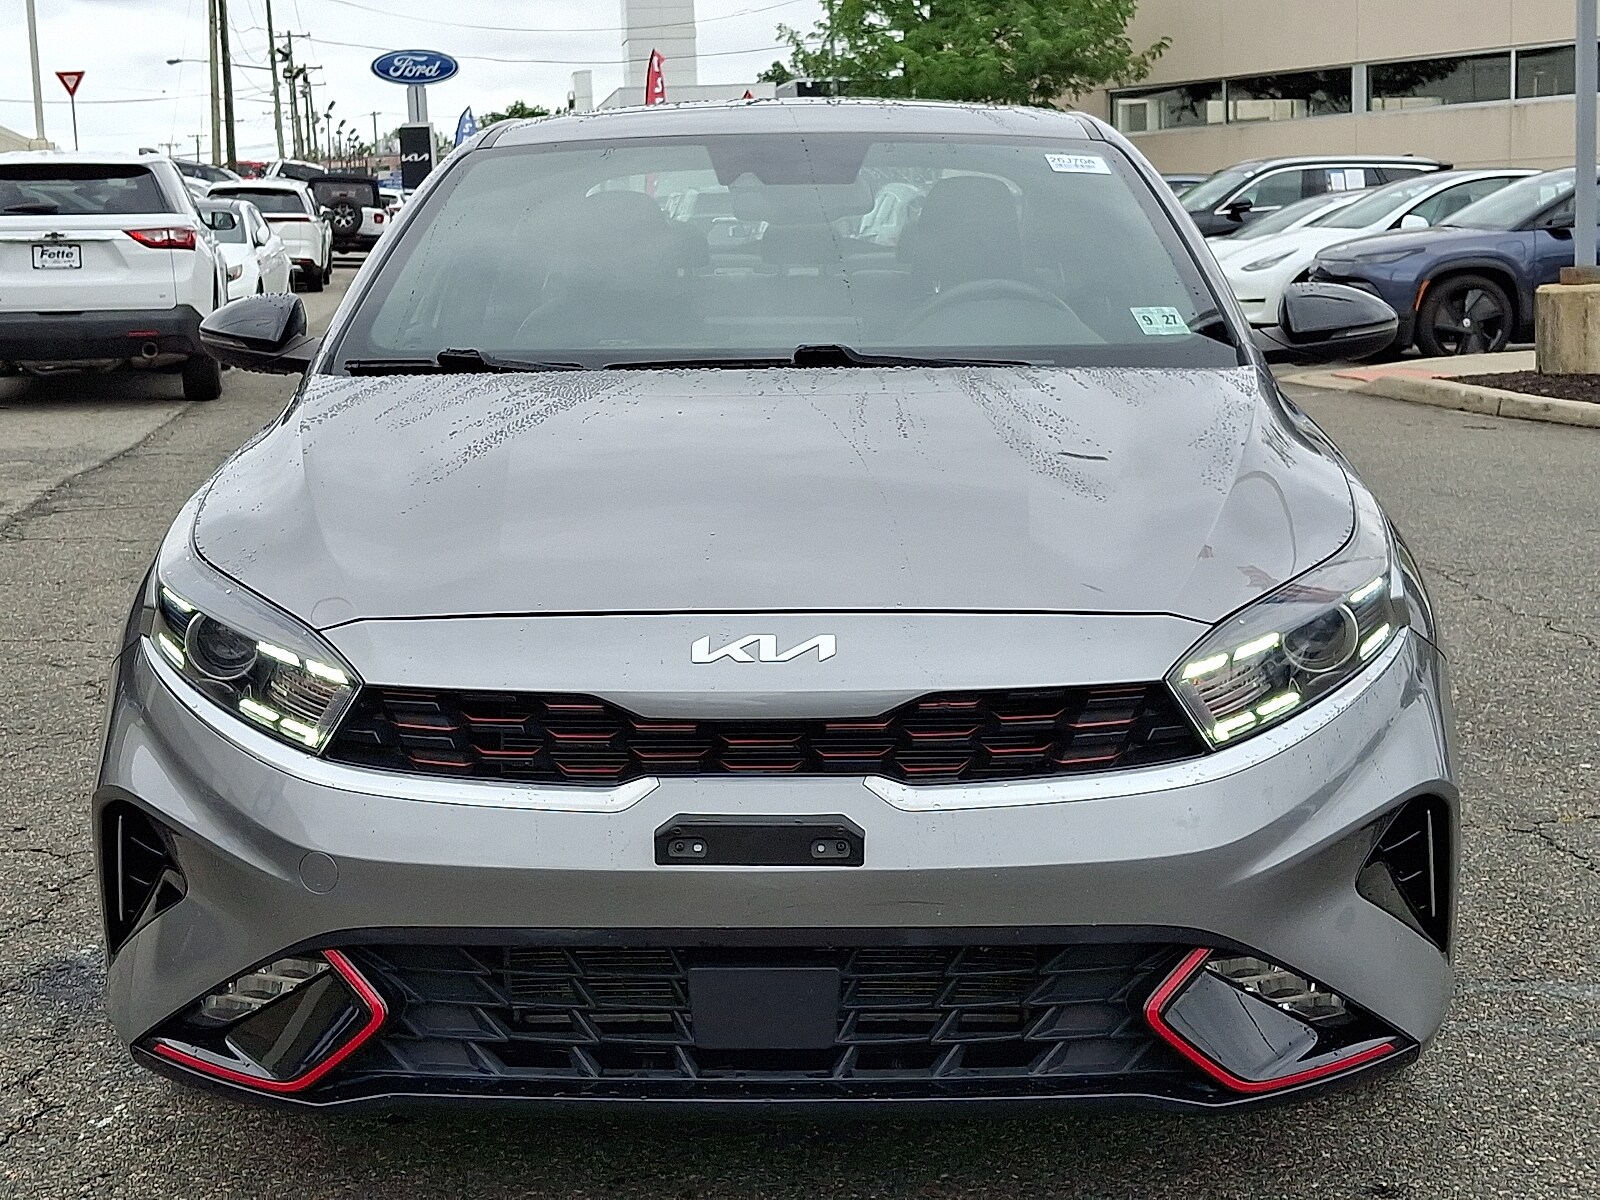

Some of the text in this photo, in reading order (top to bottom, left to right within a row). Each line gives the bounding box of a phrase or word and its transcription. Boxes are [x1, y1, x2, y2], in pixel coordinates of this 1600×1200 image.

[389, 55, 441, 78] Ford
[401, 152, 430, 162] KIA
[1142, 314, 1177, 325] 9 27
[691, 634, 837, 664] KIA
